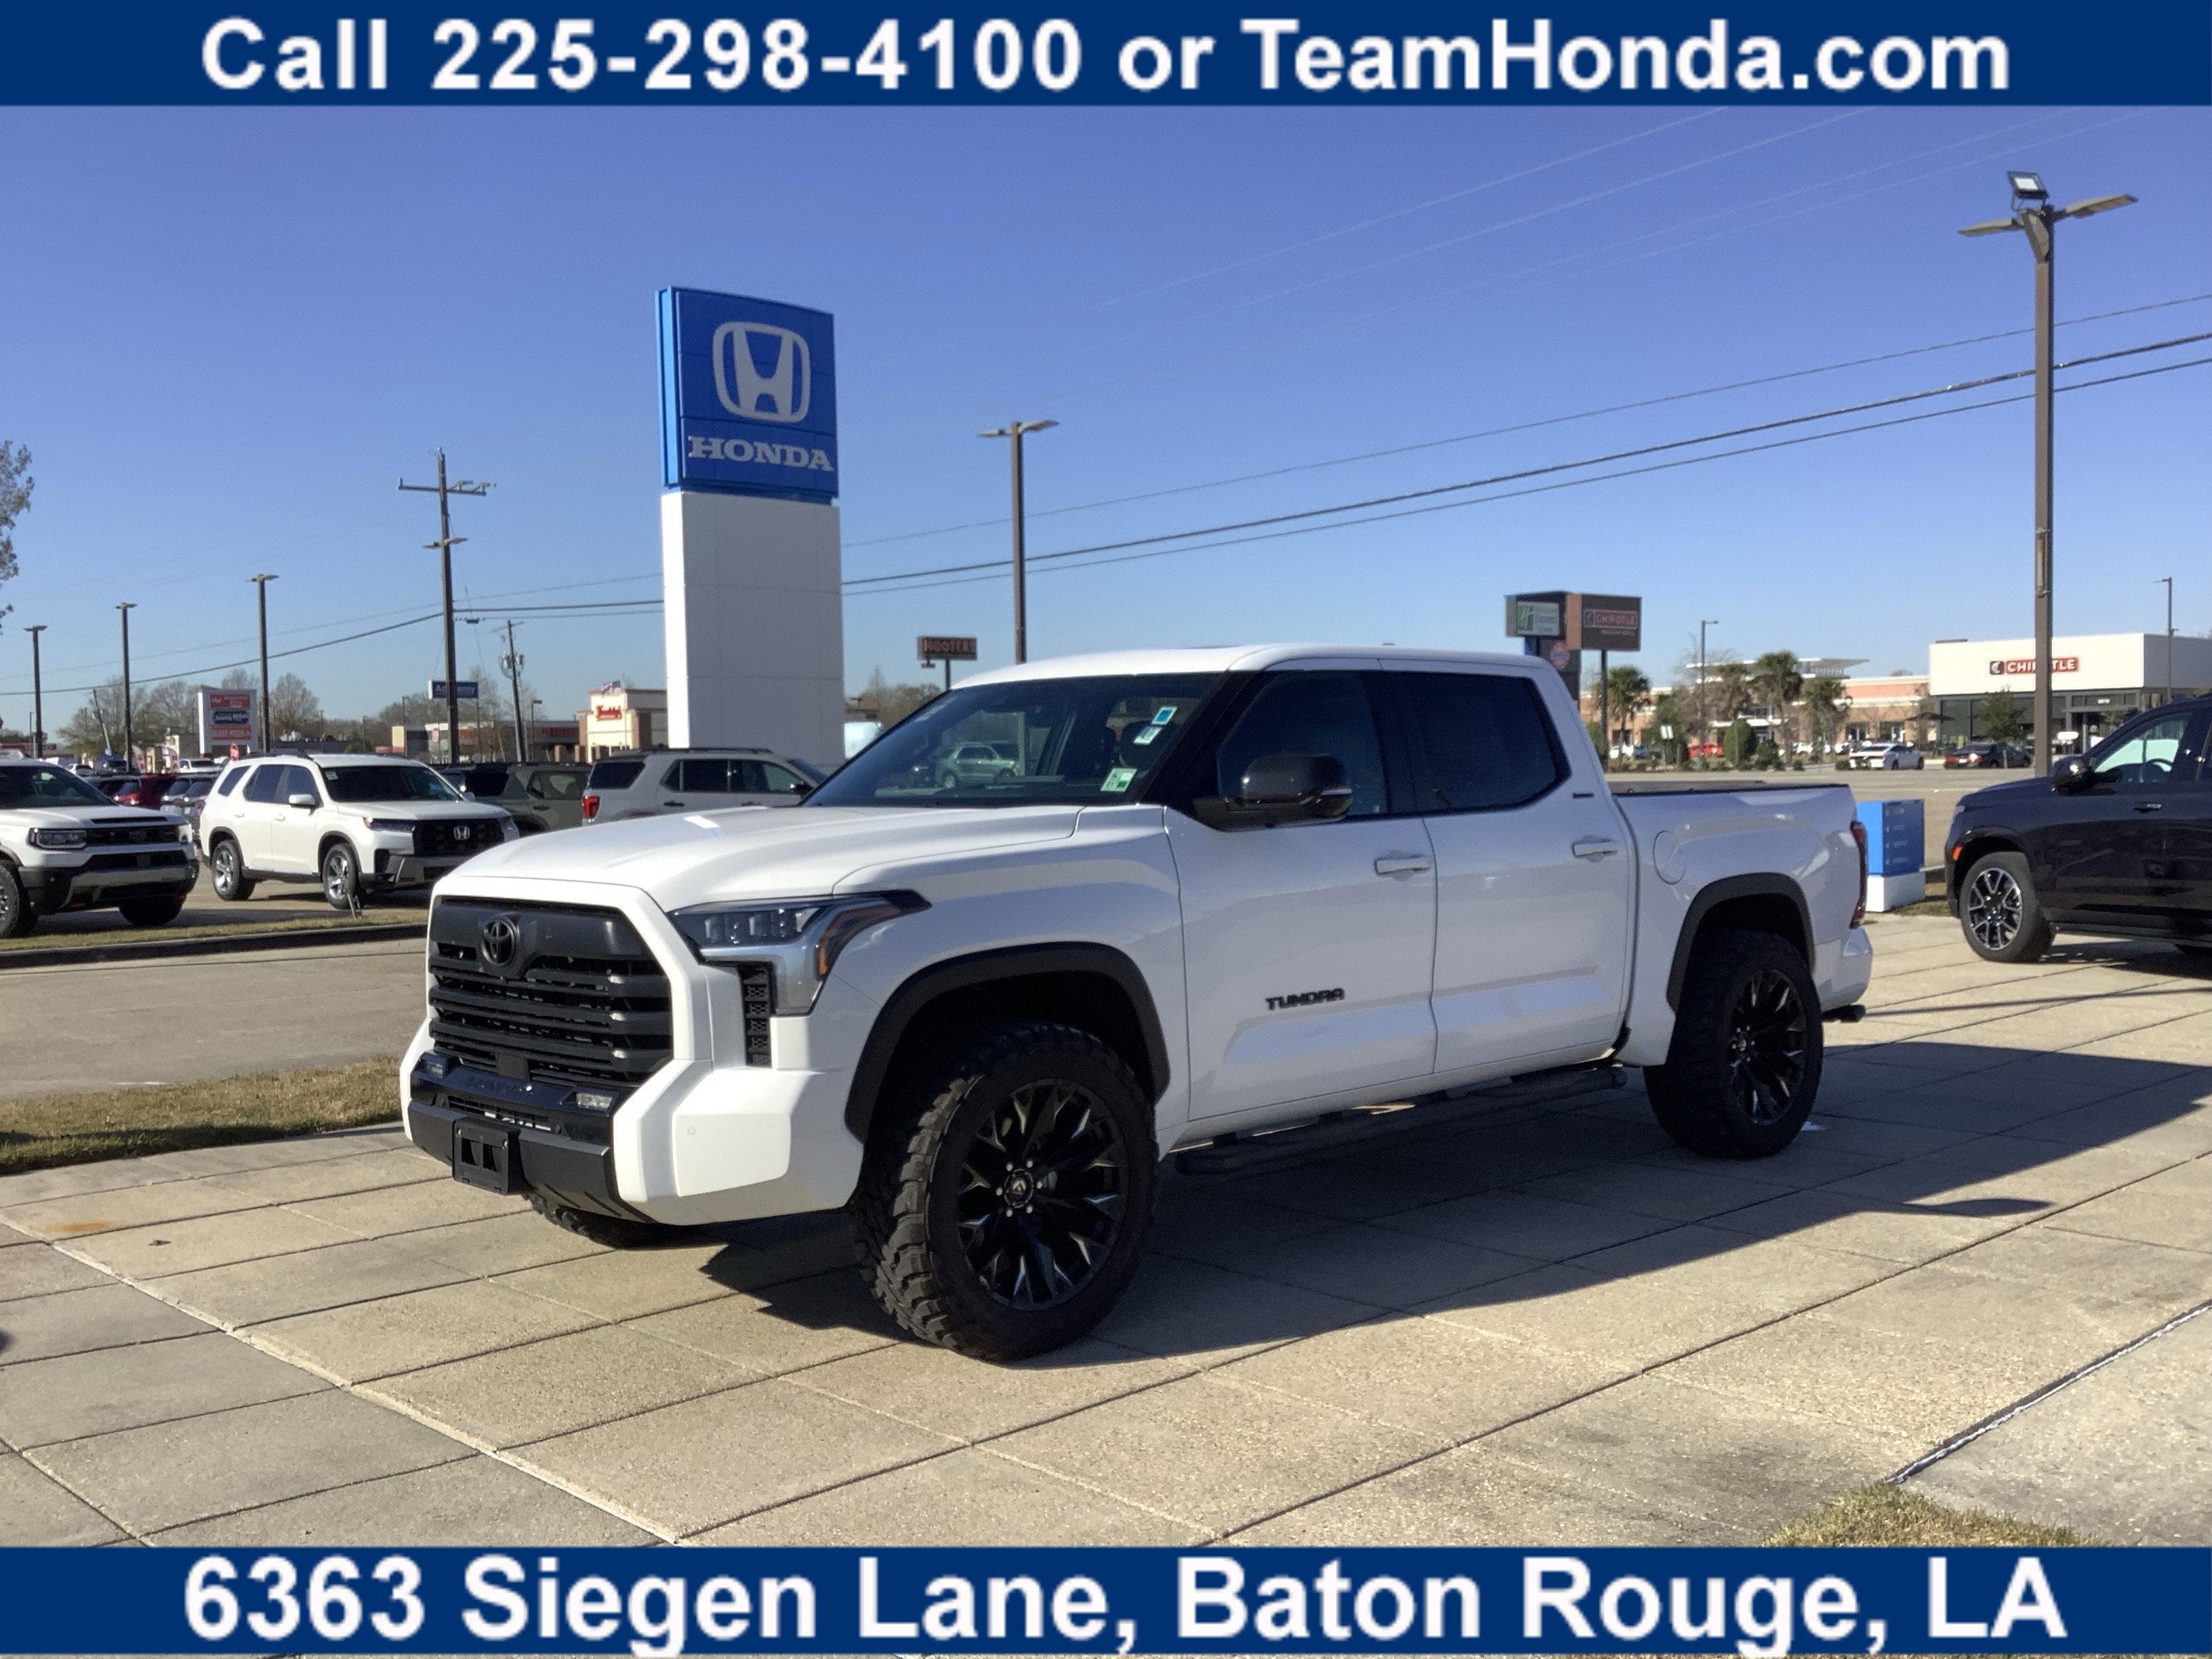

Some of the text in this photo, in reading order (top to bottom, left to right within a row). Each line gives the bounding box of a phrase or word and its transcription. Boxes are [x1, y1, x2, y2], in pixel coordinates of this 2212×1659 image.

[687, 435, 834, 472] HONDA
[1596, 613, 1636, 626] CHIPOTLE
[2007, 659, 2076, 673] CHITLE
[434, 684, 476, 695] Acemy
[1265, 987, 1346, 1010] TUNDRA
